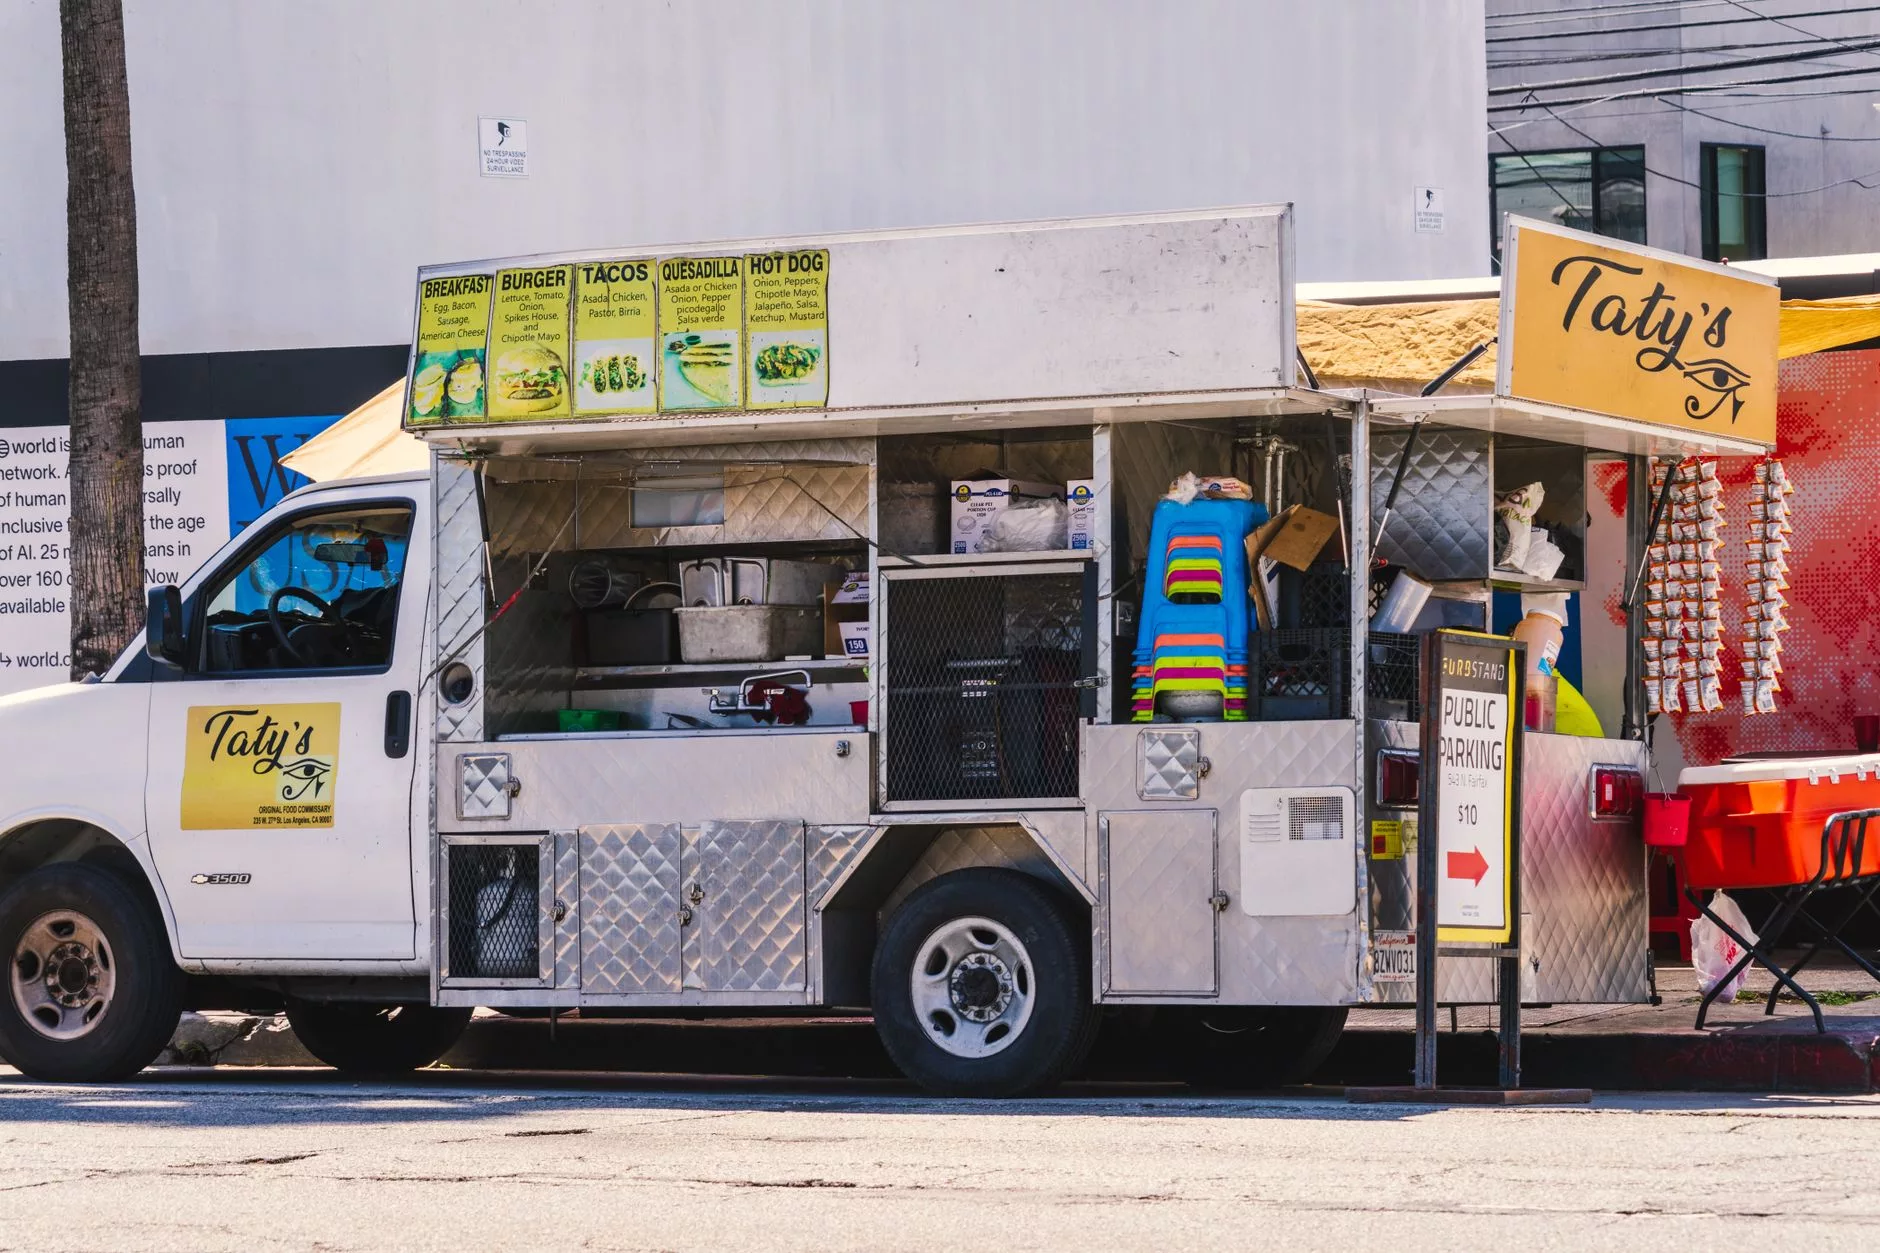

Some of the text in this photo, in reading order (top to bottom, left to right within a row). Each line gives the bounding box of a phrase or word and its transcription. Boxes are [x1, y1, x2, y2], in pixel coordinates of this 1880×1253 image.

[492, 150, 526, 158] TRESPASSING
[750, 253, 823, 274] HOT DOG
[582, 264, 648, 284] TACOS
[662, 260, 738, 280] QUESADILLA
[502, 270, 566, 290] BURGER
[754, 278, 820, 288] Onion, Peppers,
[425, 276, 490, 298] BREAKFAST
[665, 284, 690, 293] Asada
[704, 282, 738, 291] Chicken
[502, 292, 565, 303] Lettuce, Tomato,
[612, 291, 648, 302] Chicken,
[671, 294, 731, 304] Onion, Pepper
[754, 290, 790, 300] Chipotle
[434, 302, 476, 314] Egg, Bacon,
[519, 303, 544, 312] Onion,
[796, 300, 820, 309] Salsa,
[504, 312, 559, 324] Spikes House,
[589, 307, 640, 318] Pastor, Birria
[750, 311, 824, 323] Ketchup, Mustard
[1551, 256, 1732, 372] Taty's
[437, 316, 470, 326] Sausage,
[678, 314, 725, 324] Salsa verde
[524, 322, 538, 331] and
[420, 328, 486, 340] American Cheese
[502, 332, 560, 343] Chipotle Mayo
[12, 437, 56, 454] world
[142, 436, 184, 450] uman
[158, 459, 196, 480] proof
[0, 487, 180, 507] of human rsally
[2, 518, 63, 534] nclusive
[150, 514, 174, 530] the
[178, 516, 206, 532] age
[0, 545, 12, 560] of
[40, 544, 59, 560] 25
[178, 541, 190, 556] in
[0, 574, 32, 587] over
[36, 570, 62, 587] 160
[144, 568, 179, 584] Now
[0, 598, 65, 614] available
[848, 640, 864, 650] 150
[1444, 695, 1496, 730] PUBLIC
[204, 709, 314, 774] Taty's
[1440, 736, 1502, 770] PARKING
[258, 804, 330, 814] ORIGINAL FOOD COMMISSARY
[1458, 804, 1478, 826] $10
[212, 874, 250, 884] 3500
[1374, 950, 1414, 974] 8ZWV031
